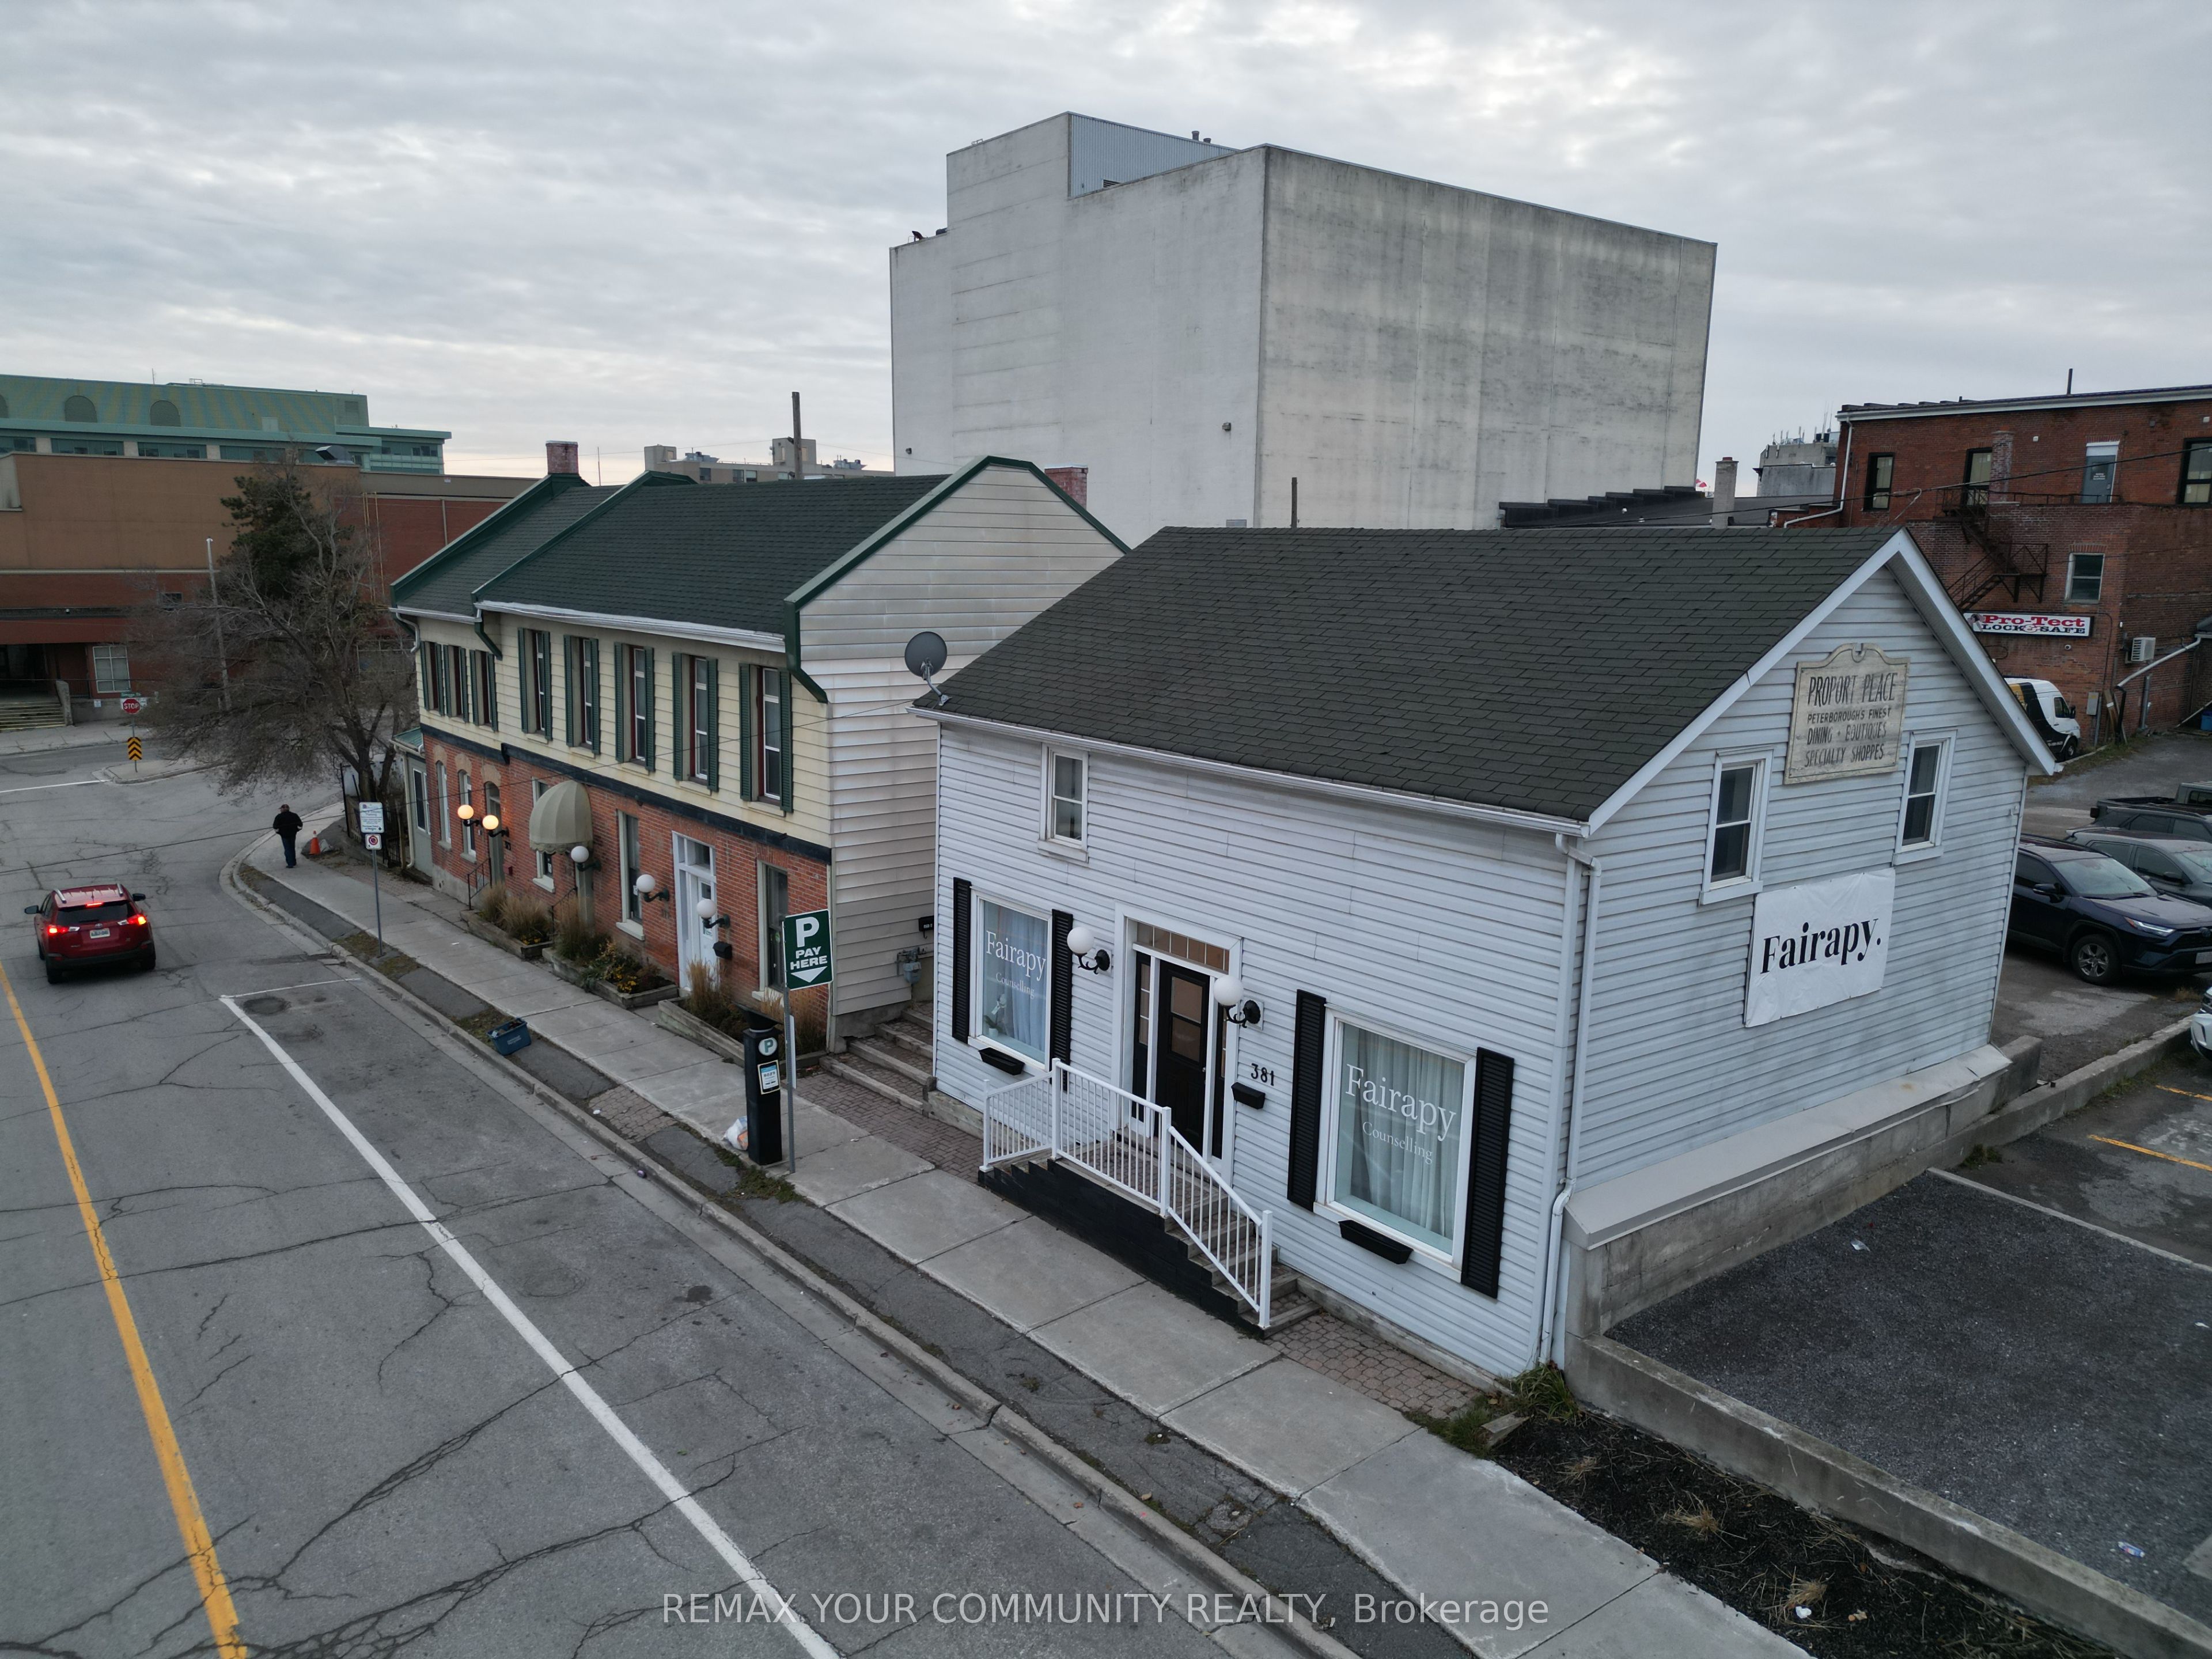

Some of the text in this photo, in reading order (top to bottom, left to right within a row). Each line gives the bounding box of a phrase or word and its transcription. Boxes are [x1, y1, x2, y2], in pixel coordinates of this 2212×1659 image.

[1982, 615, 2085, 627] Pro-Tect
[1808, 673, 1898, 707] PROPORT PLACE
[1869, 707, 1892, 719] FINEST
[1807, 722, 1887, 745] DINING BOUTIQUES
[1805, 744, 1885, 767] SPECIALTY SHOPPES
[796, 916, 820, 948] P
[796, 946, 822, 959] PAY
[986, 930, 1047, 982] Fairapy
[1760, 918, 1881, 974] Fairapy.
[790, 955, 828, 970] HERE
[995, 972, 1035, 999] Counselling
[764, 1039, 773, 1053] P
[1251, 1063, 1274, 1086] 381
[1345, 1064, 1457, 1142] Fairapy
[1362, 1122, 1434, 1165] Counselling
